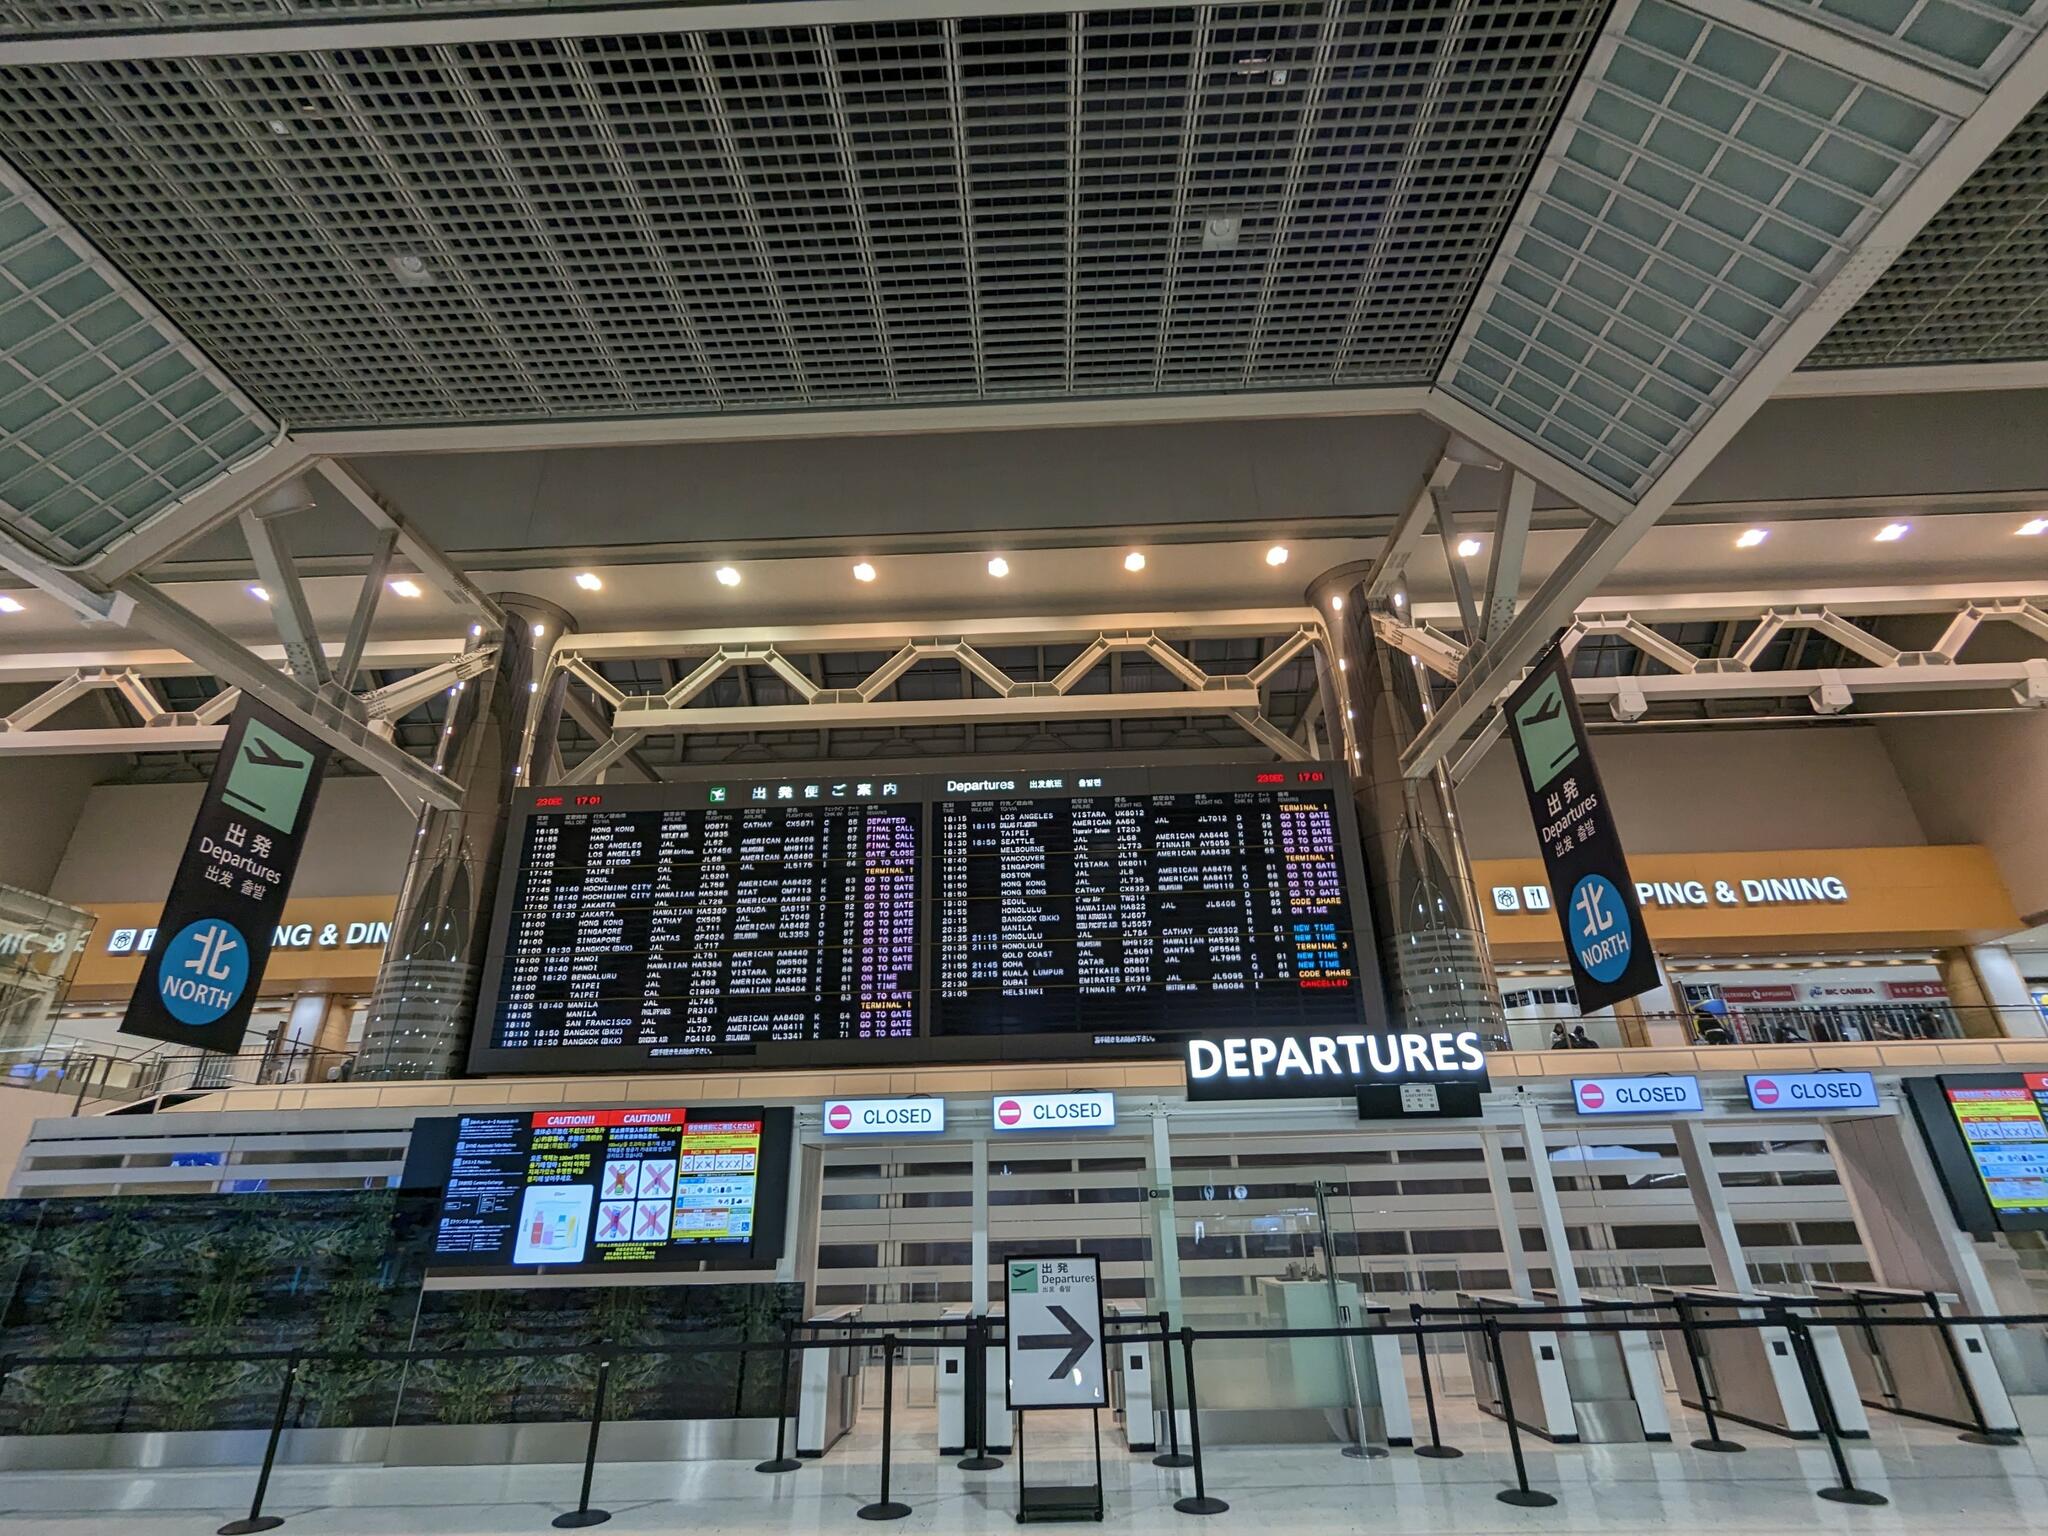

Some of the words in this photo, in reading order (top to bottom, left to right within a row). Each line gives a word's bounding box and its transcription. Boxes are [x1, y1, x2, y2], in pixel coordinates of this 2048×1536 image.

[752, 783, 896, 800] 出発便ご案内
[947, 780, 1014, 792] Departures
[1547, 778, 1580, 817] 出発
[1279, 803, 1318, 811] TERMINAL
[1542, 793, 1598, 843] Departures
[225, 822, 272, 858] 出発
[607, 841, 641, 849] ANGELES
[1000, 845, 1044, 853] MELBOURNE
[200, 836, 281, 884] Departures
[1635, 882, 1708, 905] PING
[1715, 881, 1738, 904] &
[1742, 877, 1848, 903] DINING
[1576, 882, 1614, 937] 北
[318, 924, 339, 946] &
[578, 927, 621, 935] SINGAPORE
[1002, 932, 1042, 940] HONOLULU
[1293, 924, 1309, 932] NEW
[1314, 923, 1334, 931] TIME
[185, 926, 237, 979] 北
[1581, 931, 1629, 969] NORTH
[1033, 968, 1063, 976] LUMPUR
[1079, 976, 1120, 984] EMIRATES
[1299, 970, 1320, 978] CODE
[1325, 969, 1351, 977] SHARE
[1300, 979, 1347, 987] CANCELLED
[163, 976, 233, 1010] NORTH
[585, 1018, 631, 1026] FRANCISCO
[1189, 1032, 1484, 1078] DEPARTURES
[1616, 1087, 1687, 1104] CLOSED
[1791, 1082, 1862, 1100] CLOSED
[548, 1115, 595, 1124] CAUTION!!
[624, 1113, 671, 1123] CAUTION!!
[863, 1108, 932, 1125] CLOSED
[1033, 1103, 1102, 1120] CLOSED
[1042, 1263, 1069, 1274] 出発
[1042, 1274, 1096, 1286] Departures
